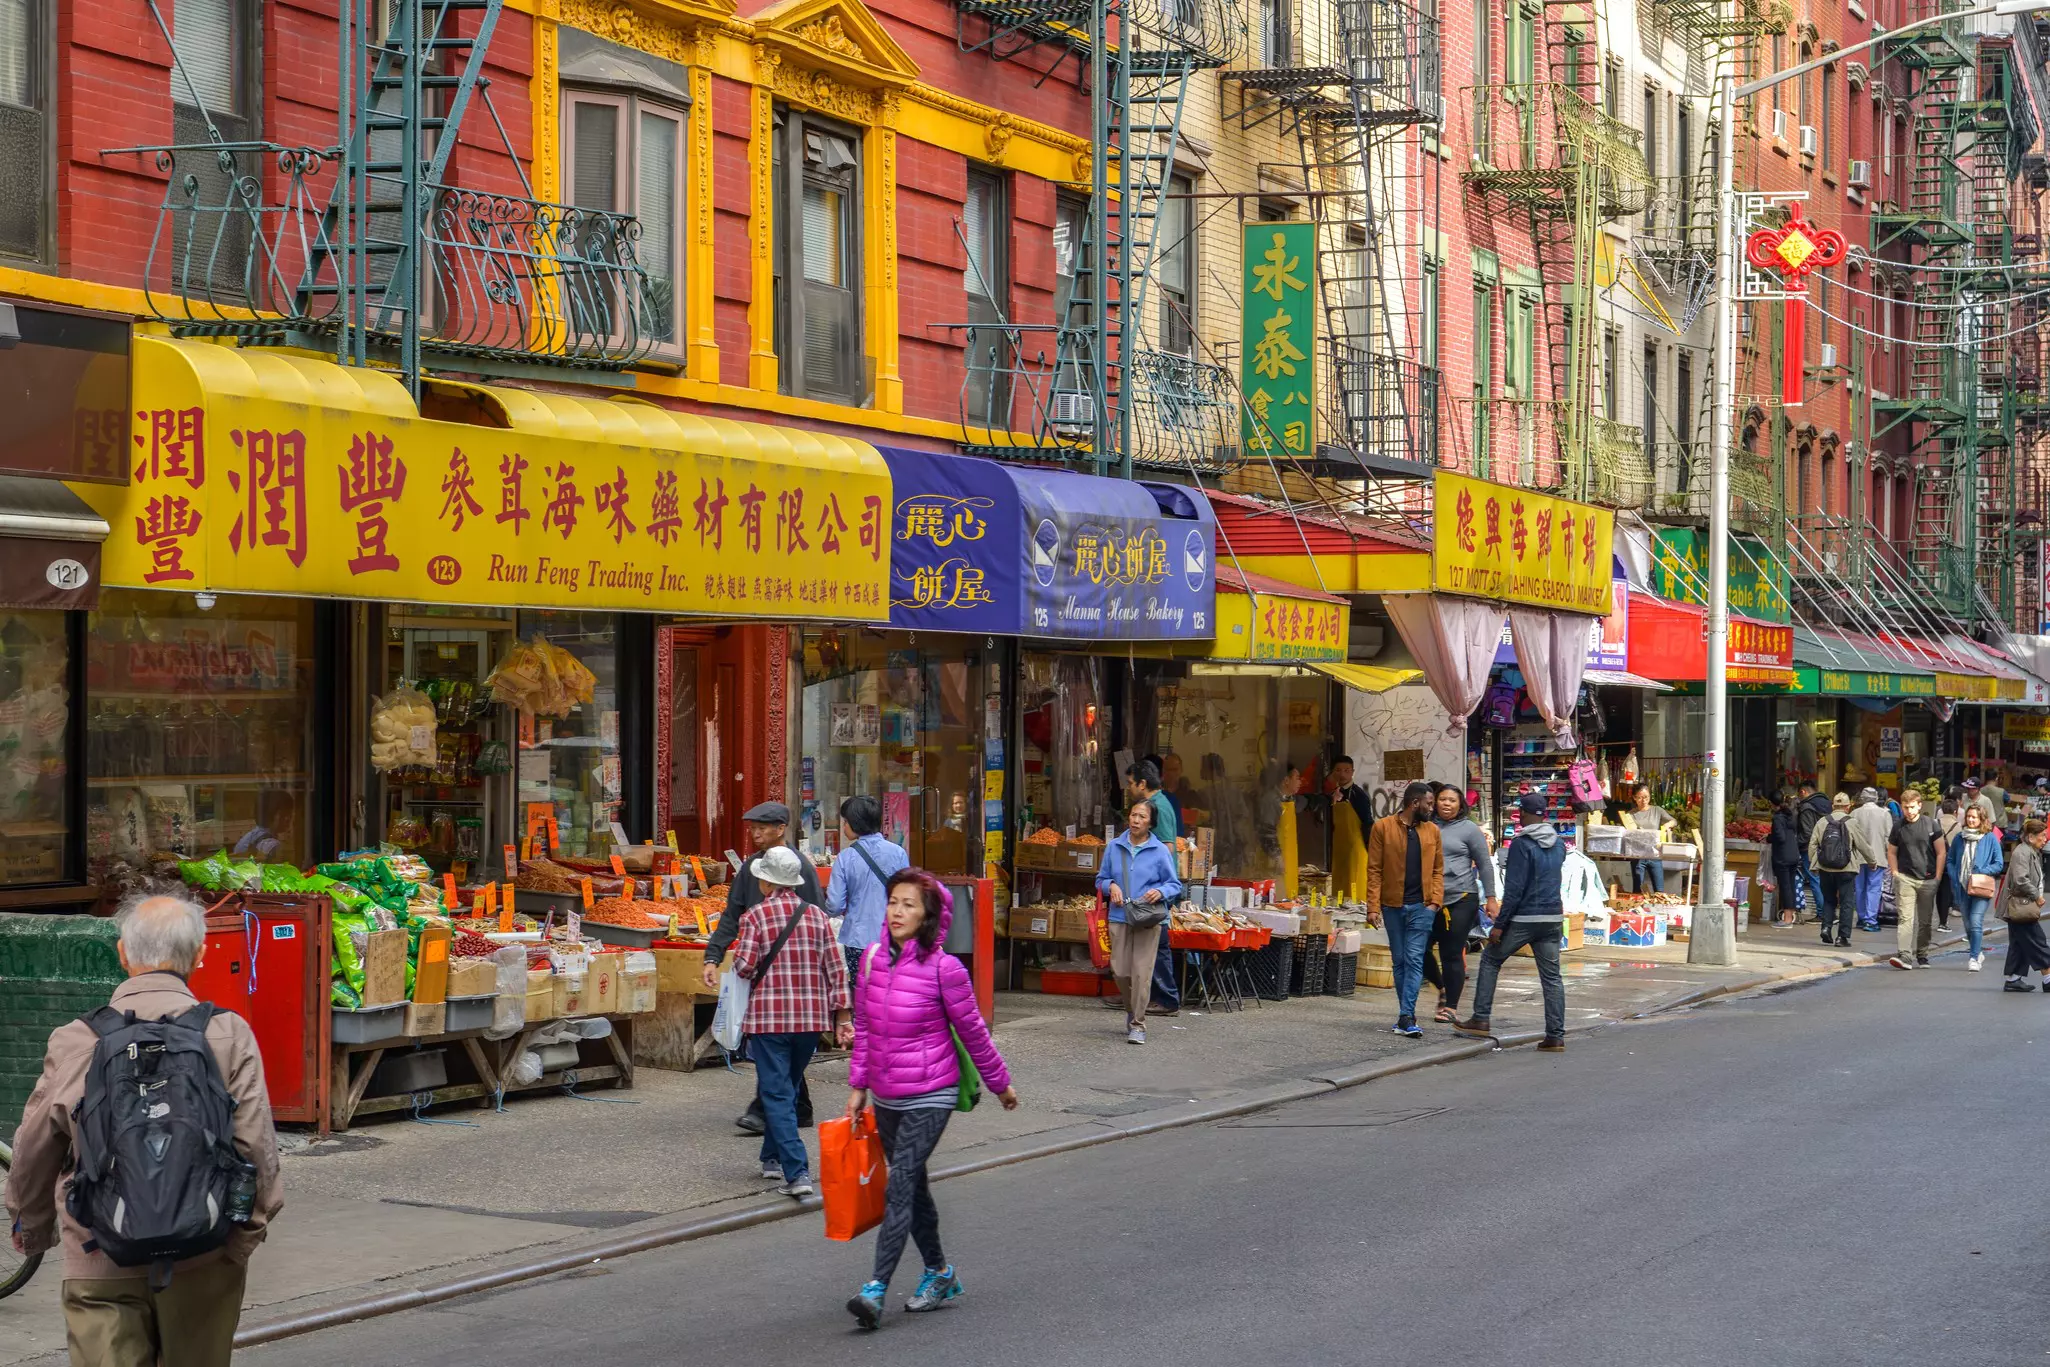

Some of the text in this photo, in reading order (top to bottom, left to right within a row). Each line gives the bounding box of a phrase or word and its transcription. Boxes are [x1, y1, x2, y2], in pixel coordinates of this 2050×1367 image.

[1782, 239, 1803, 260] 福
[1251, 232, 1308, 380] 永泰
[1248, 387, 1274, 452] 食品
[134, 406, 205, 584] 潤豐
[55, 564, 79, 585] 121
[434, 558, 456, 582] 123
[487, 553, 689, 596] Run Feng Trading Inc.
[1449, 565, 1464, 588] 127
[1466, 568, 1489, 591] MOTT
[1542, 578, 1576, 604] SEAFOOD
[1577, 585, 1605, 608] MARKET
[1701, 582, 1754, 608] Vtable
[1034, 607, 1049, 628] 125
[1058, 595, 1184, 630] Manna House Bakery
[1193, 612, 1205, 630] 125
